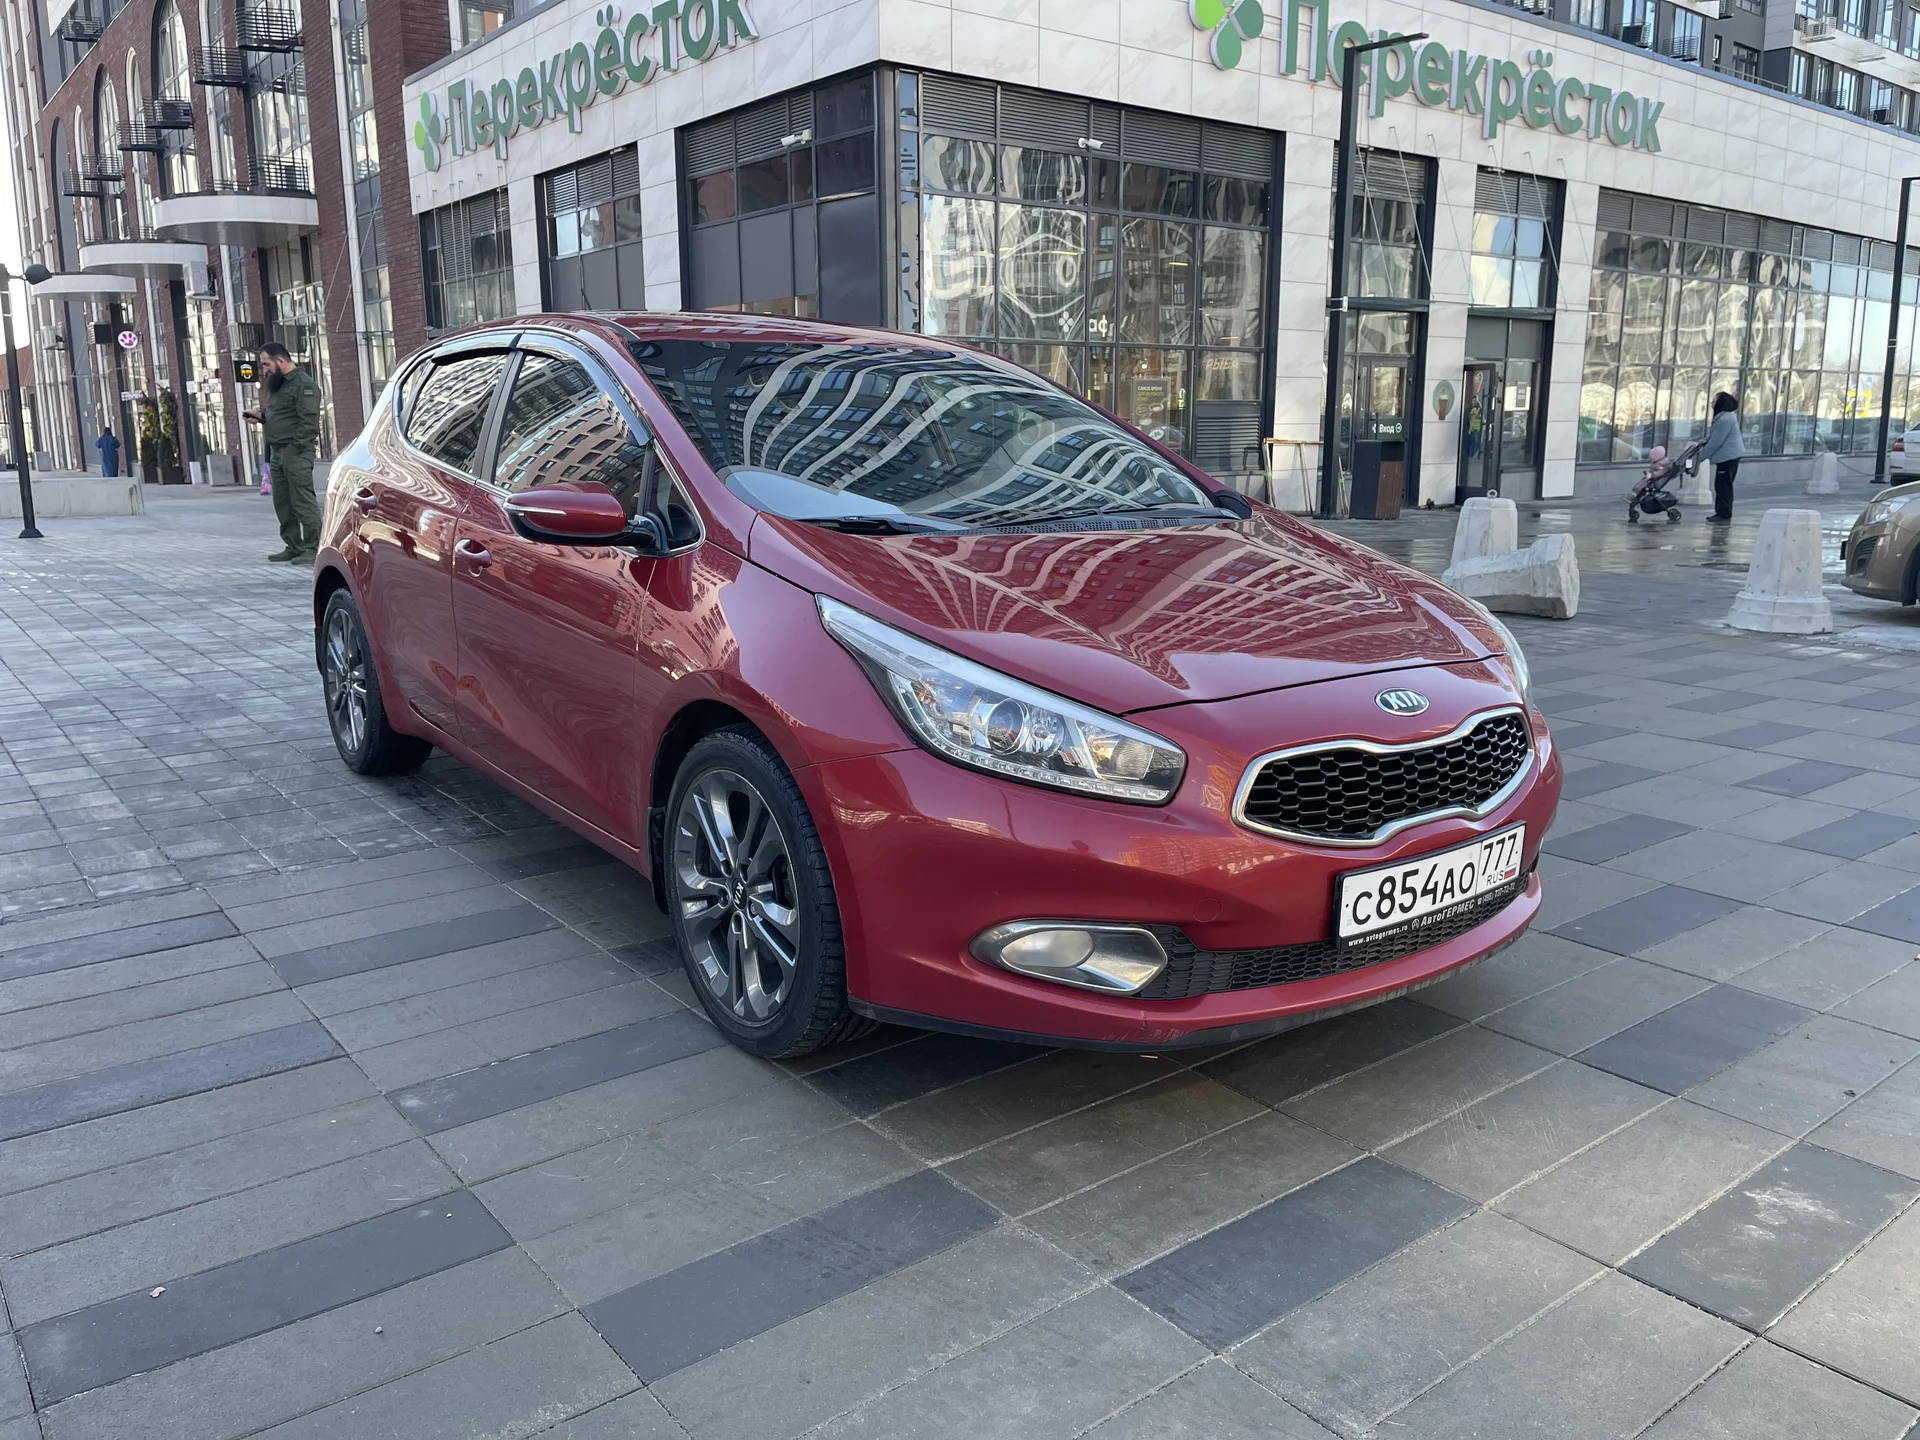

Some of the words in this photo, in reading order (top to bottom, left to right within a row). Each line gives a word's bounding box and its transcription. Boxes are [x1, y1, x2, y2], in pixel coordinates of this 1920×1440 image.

[448, 0, 759, 160] Перекрёсток
[1279, 0, 1665, 153] Перекрёсток
[1379, 423, 1395, 433] Вход
[1382, 691, 1425, 709] KIA
[1352, 862, 1475, 925] С854АО
[1482, 832, 1517, 876] 777
[1486, 870, 1504, 886] RUS
[734, 881, 744, 904] KIA
